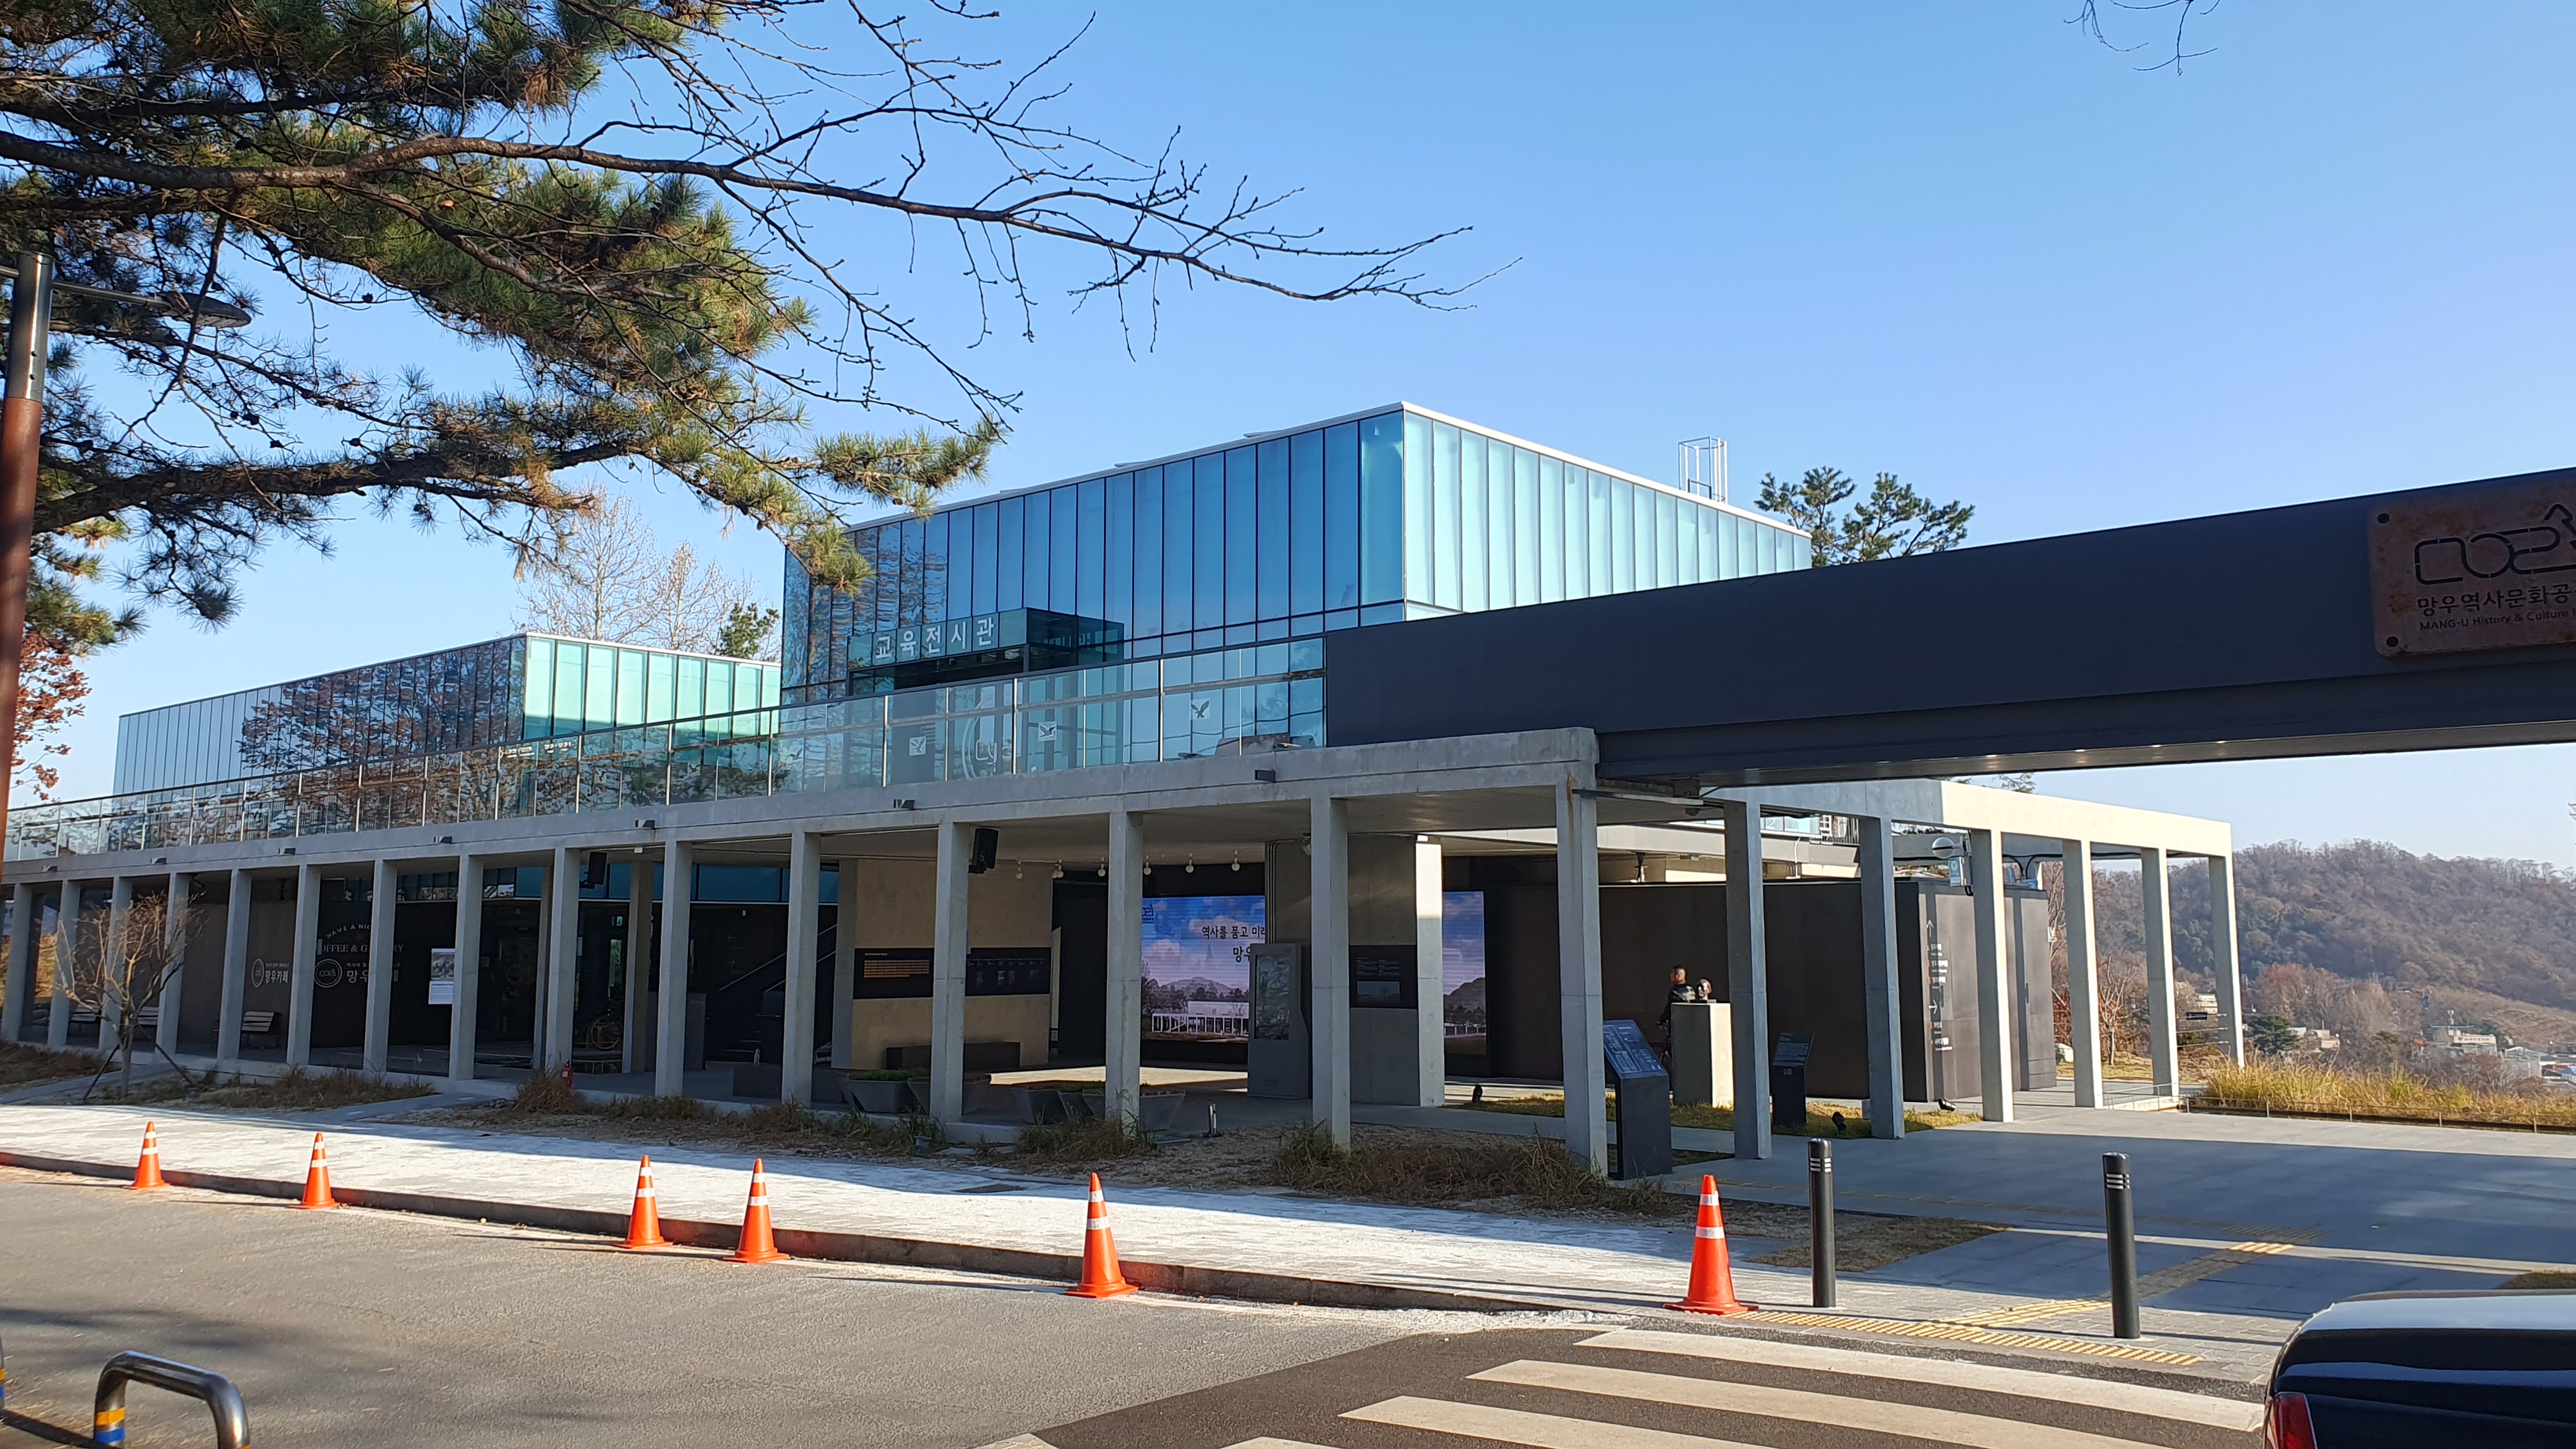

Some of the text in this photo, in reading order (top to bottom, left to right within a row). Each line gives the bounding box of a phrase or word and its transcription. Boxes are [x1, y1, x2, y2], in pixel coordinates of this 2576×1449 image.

[2418, 583, 2576, 617] 망우역사문화공
[2419, 618, 2469, 631] MANG-U
[2472, 615, 2511, 627] History
[2514, 613, 2522, 622] &
[2526, 608, 2569, 622] Culture
[875, 617, 995, 659] 교육전시관
[326, 925, 348, 939] HAVE
[1202, 926, 1228, 940] 역사를
[1230, 926, 1249, 939] 품고
[323, 944, 349, 953] FFEE
[351, 944, 358, 953] &
[265, 970, 289, 983] 망우카페
